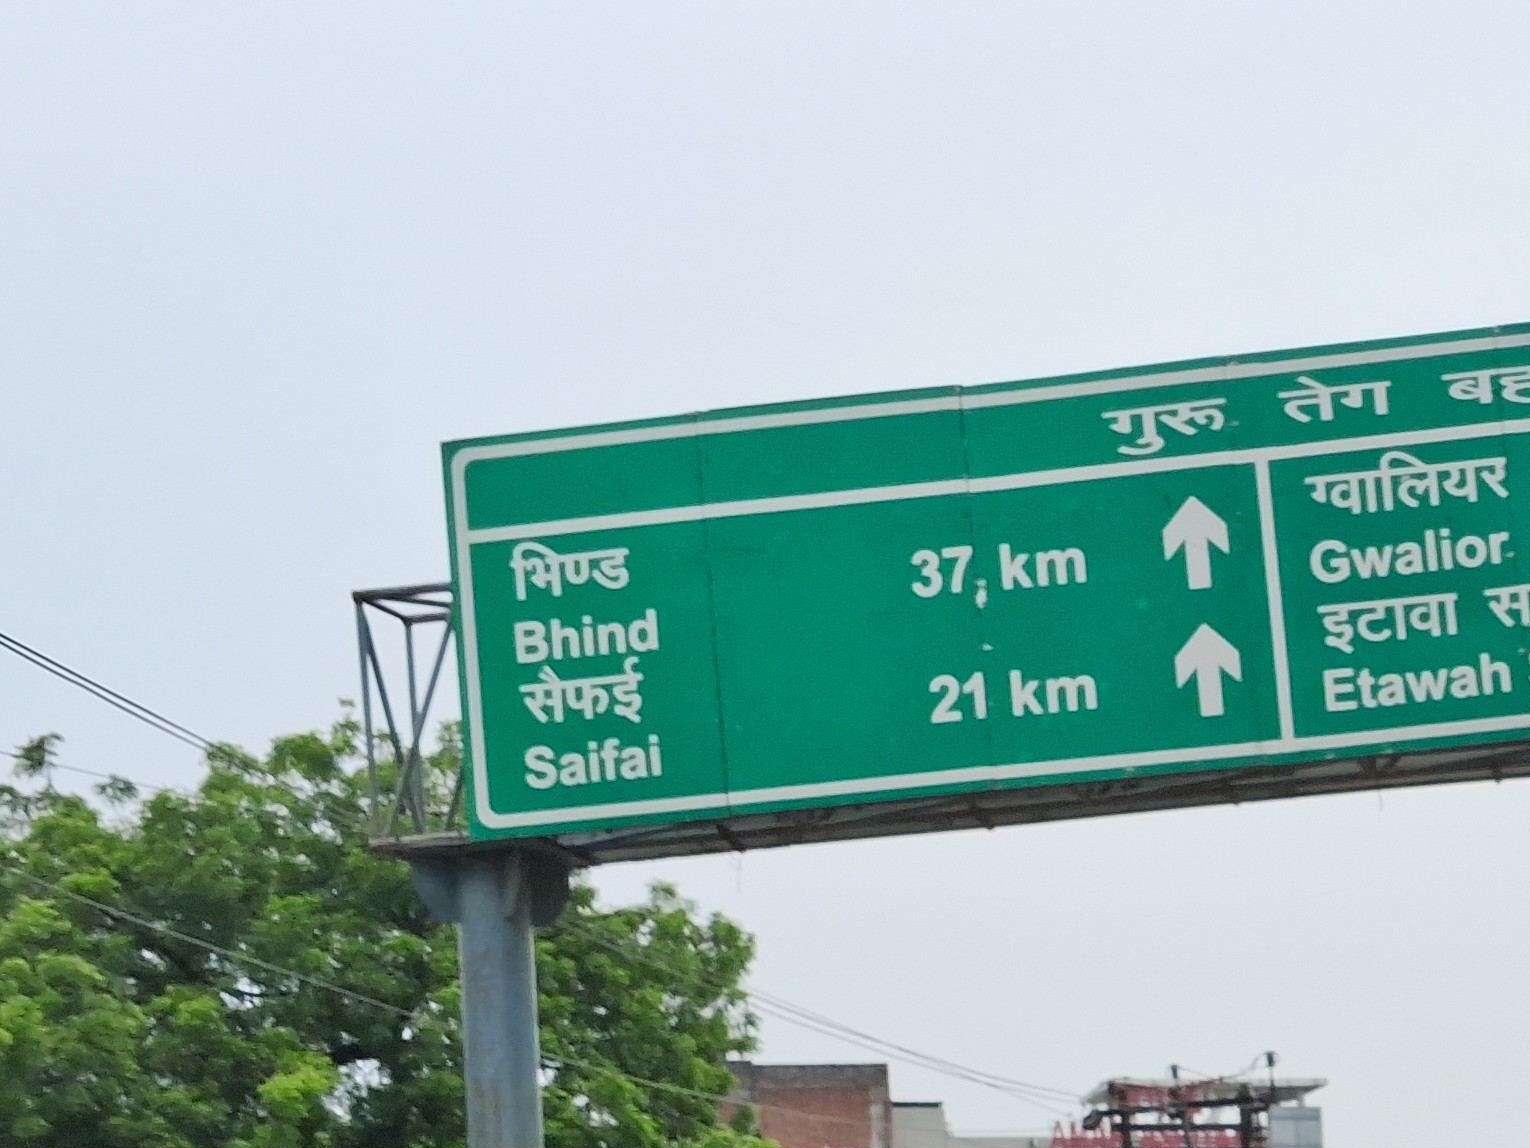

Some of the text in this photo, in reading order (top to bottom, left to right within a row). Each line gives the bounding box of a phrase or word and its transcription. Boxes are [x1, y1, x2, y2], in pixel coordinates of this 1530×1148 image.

[1103, 398, 1226, 455] गुरू
[1279, 374, 1391, 423] तेग
[1304, 451, 1510, 515] ग्वालियर
[511, 542, 630, 600] भिण्ड
[911, 543, 1087, 598] 37 km
[1309, 528, 1508, 583] Gwalior
[513, 609, 660, 664] Bhind
[1317, 593, 1458, 653] इटावा
[519, 656, 644, 724] सैफई
[928, 670, 1098, 723] 21 km
[1323, 652, 1512, 712] Etawah
[525, 735, 662, 789] Saifai
